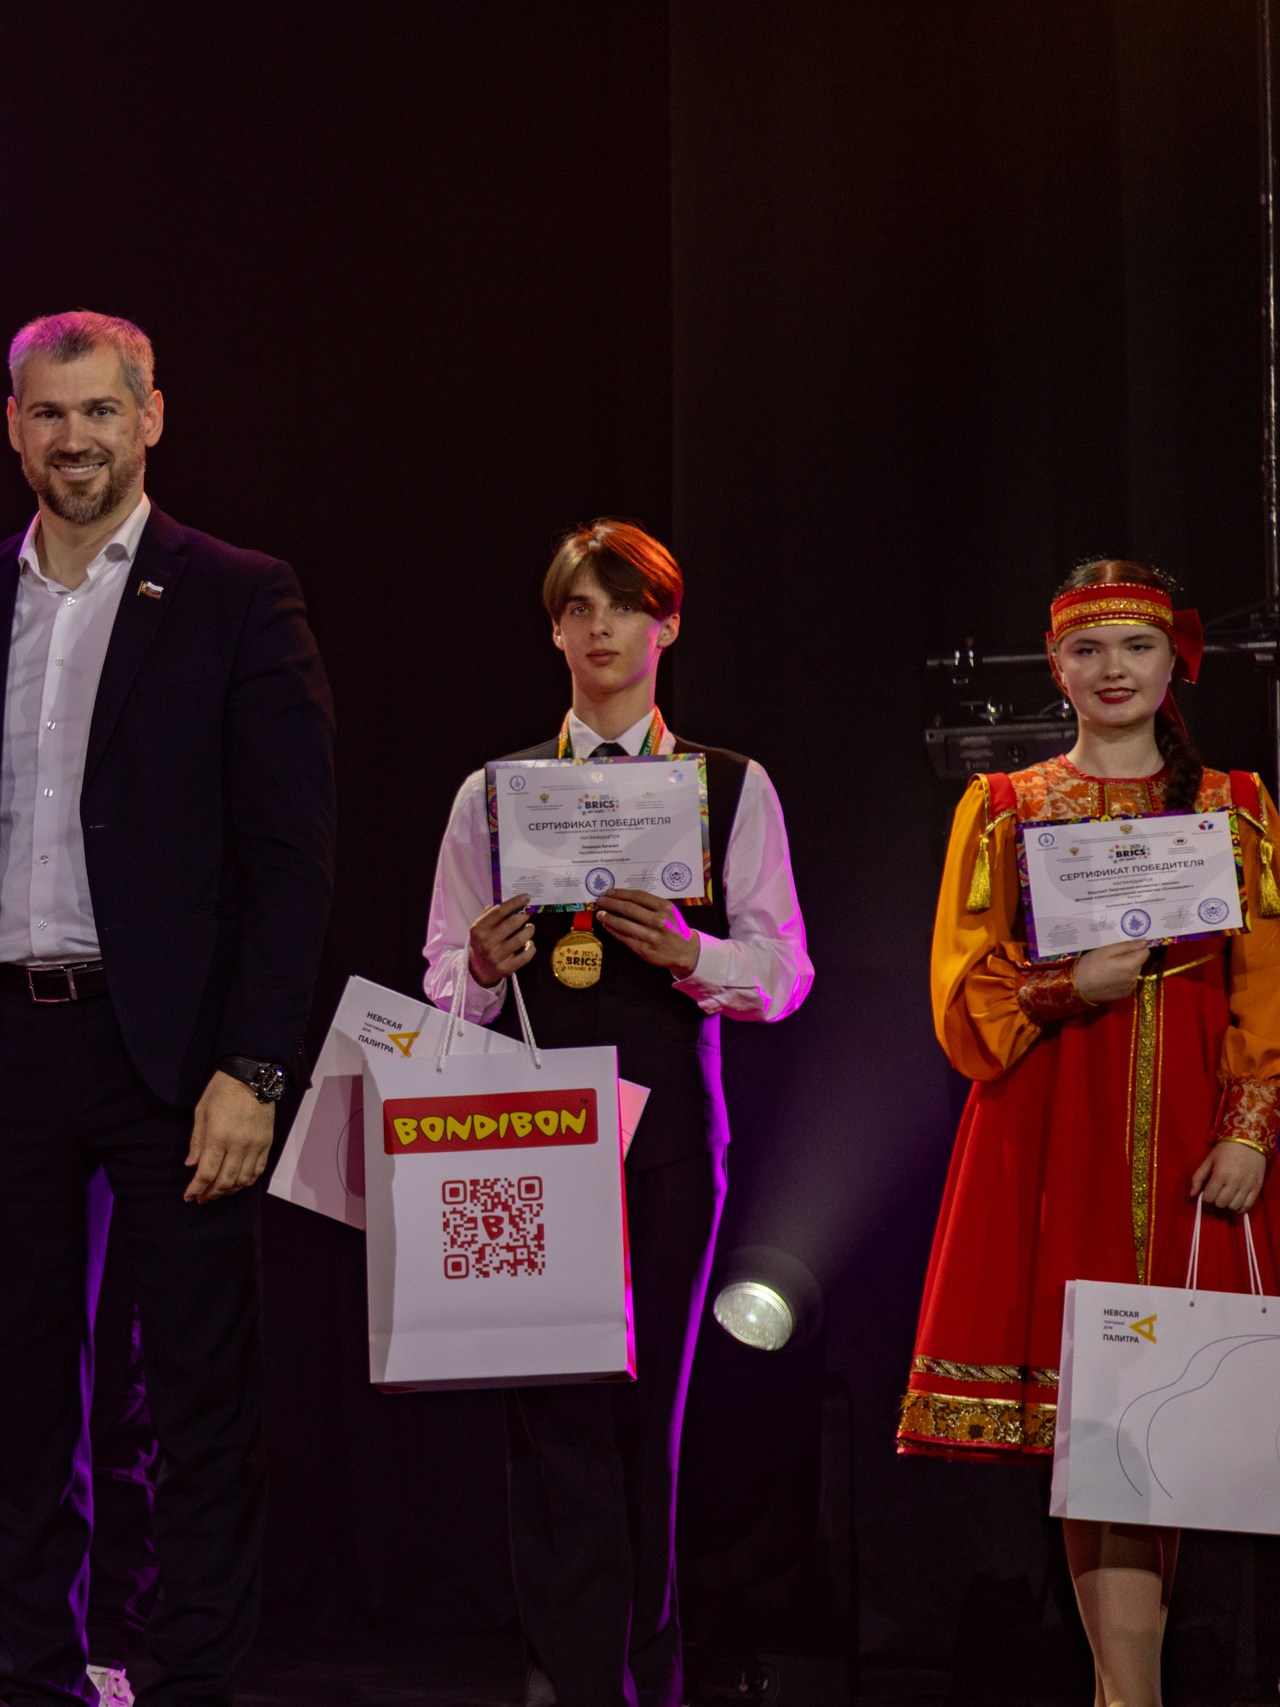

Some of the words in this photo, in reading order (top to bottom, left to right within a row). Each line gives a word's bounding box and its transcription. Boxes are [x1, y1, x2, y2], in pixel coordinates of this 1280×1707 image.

[585, 800, 614, 809] BRICS
[528, 820, 597, 830] СЕРТИФИКАТ
[600, 816, 670, 827] ПОБЕДИТЕЛЯ
[1115, 848, 1146, 857] BRICS
[1059, 866, 1129, 881] СЕРТИФИКАТ
[1132, 858, 1204, 872] ПОБЕДИТЕЛЯ
[566, 956, 597, 966] BRICS
[366, 1011, 402, 1030] НЕВСКАЯ
[358, 1034, 394, 1054] ПАЛИТРА
[393, 1108, 587, 1146] BONDIBON
[1103, 1309, 1139, 1318] НЕВСКАЯ
[1103, 1334, 1139, 1343] ПАЛИТРА
